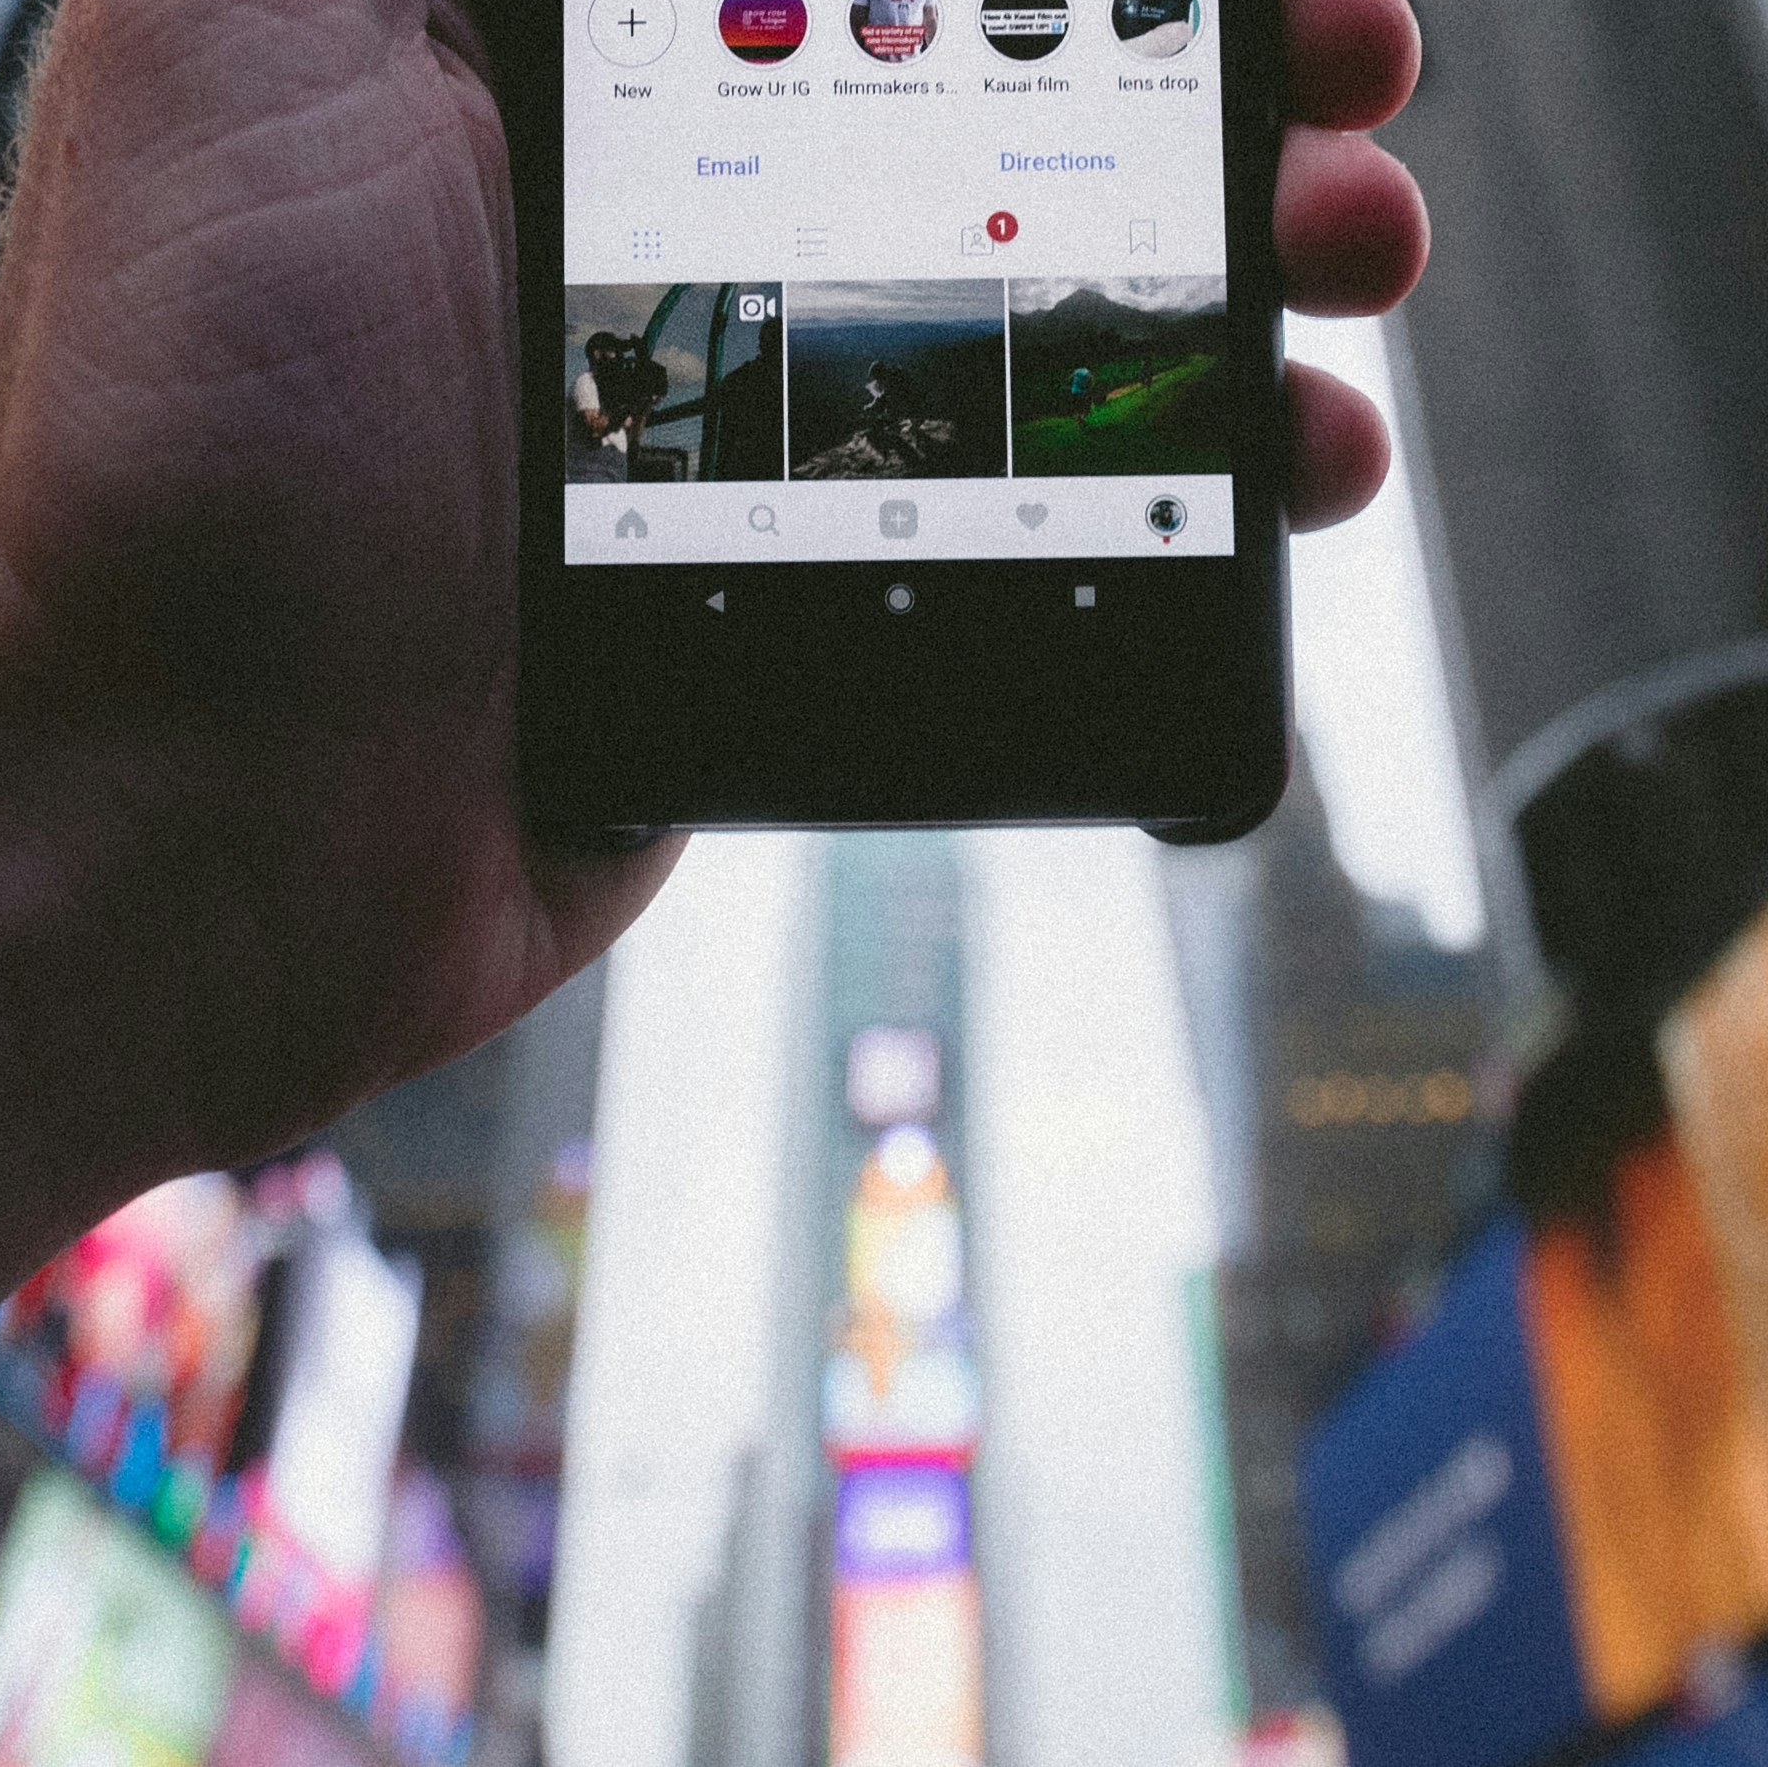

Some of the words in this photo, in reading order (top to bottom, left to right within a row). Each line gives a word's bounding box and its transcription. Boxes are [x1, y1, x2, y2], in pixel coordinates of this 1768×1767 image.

[614, 82, 652, 98] New
[718, 81, 762, 97] Grow
[768, 81, 786, 96] Ur
[792, 80, 810, 96] IG
[833, 78, 929, 96] filmmakers
[935, 82, 958, 95] s...
[984, 77, 1031, 93] Kauai
[1037, 76, 1070, 92] film
[1118, 76, 1154, 91] lens
[1159, 75, 1199, 94] drop
[697, 155, 760, 176] Email
[1000, 151, 1116, 172] Directions
[997, 218, 1006, 235] 1
